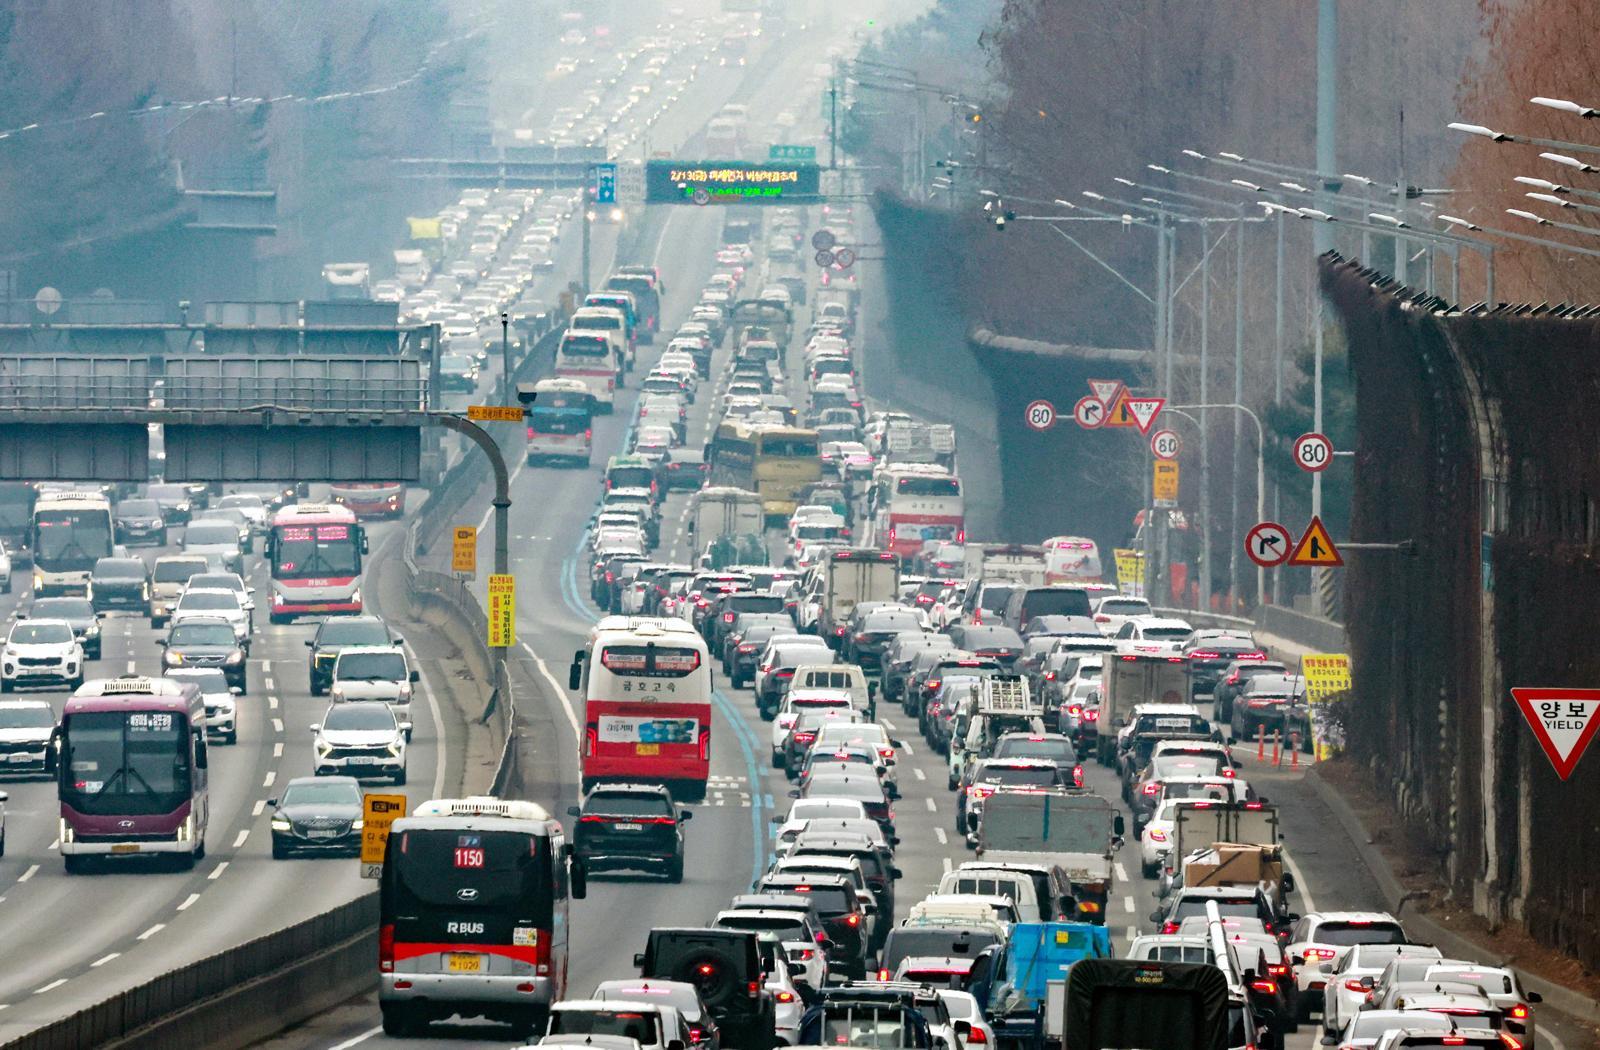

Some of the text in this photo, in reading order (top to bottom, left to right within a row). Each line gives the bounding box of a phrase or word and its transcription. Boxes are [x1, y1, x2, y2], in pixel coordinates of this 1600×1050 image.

[1031, 408, 1050, 424] 80
[1158, 438, 1177, 453] 80
[1302, 444, 1325, 463] 80
[623, 680, 676, 692] 금호고속
[1540, 701, 1588, 719] 양보
[1544, 720, 1584, 730] YIELD
[455, 849, 483, 866] 1150
